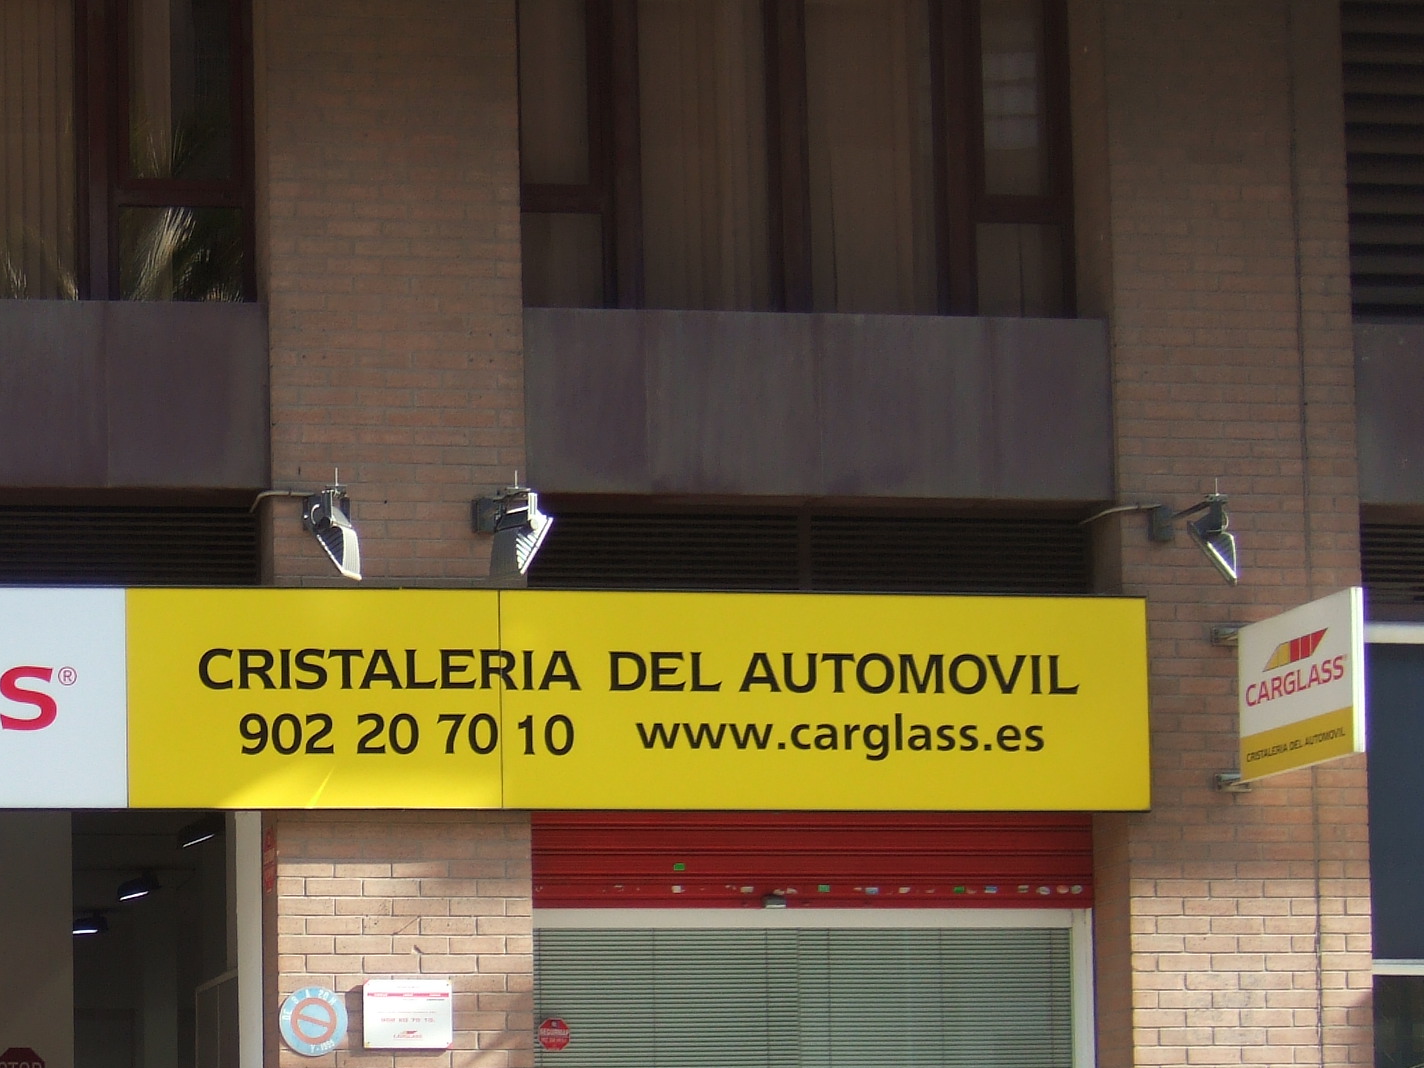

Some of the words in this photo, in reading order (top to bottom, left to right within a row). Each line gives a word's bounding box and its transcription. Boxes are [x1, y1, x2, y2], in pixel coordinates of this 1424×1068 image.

[198, 647, 582, 691] CRISTALERIA
[609, 650, 723, 693] DEL
[739, 651, 1080, 696] AUTOMOVIL
[1245, 654, 1345, 707] CARGLASS
[239, 712, 334, 755] 902
[356, 712, 420, 755] 20
[437, 712, 499, 755] 70
[518, 713, 575, 756] 10
[636, 712, 1045, 761] www.carglass.es
